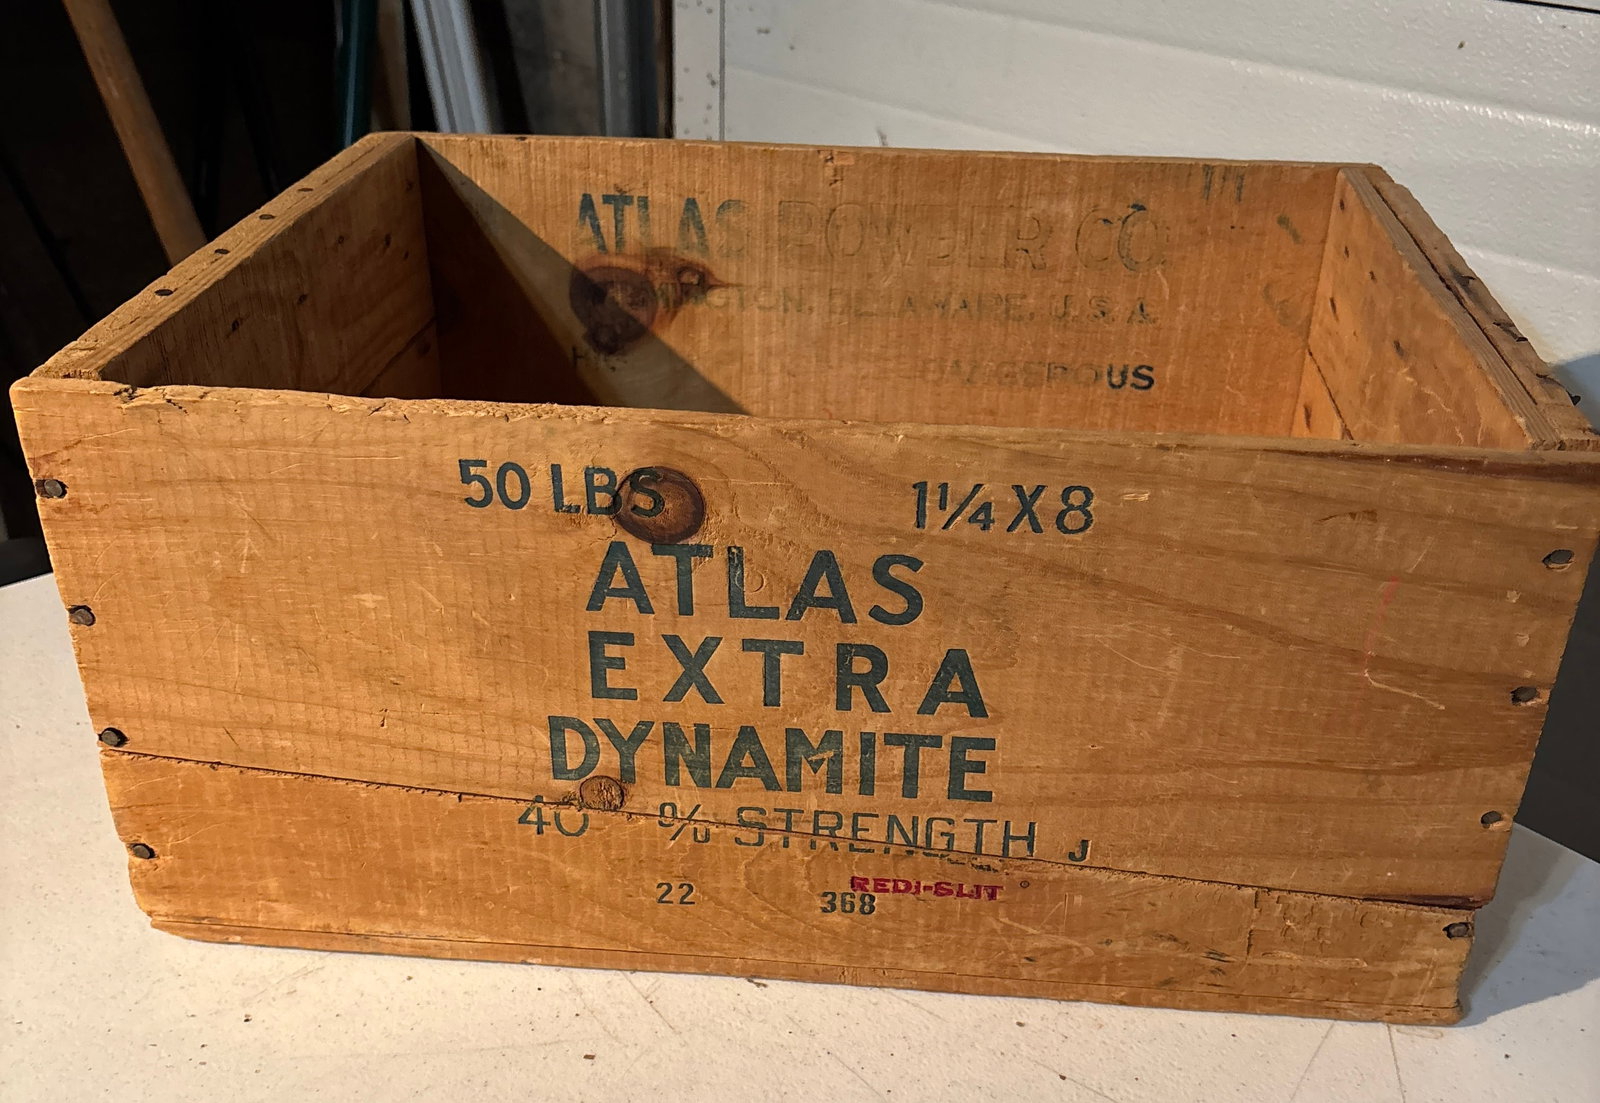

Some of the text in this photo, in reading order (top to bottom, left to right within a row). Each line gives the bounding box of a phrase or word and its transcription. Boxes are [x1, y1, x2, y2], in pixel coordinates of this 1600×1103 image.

[458, 458, 666, 519] 50 LBS
[1055, 485, 1095, 535] 8
[586, 540, 924, 626] ATLAS
[587, 630, 989, 719] EXTRA
[547, 714, 998, 803] DYNAMITE
[517, 794, 591, 837] 40
[734, 806, 1037, 860] STRENGTH
[655, 882, 696, 905] 22
[820, 891, 876, 917] 368
